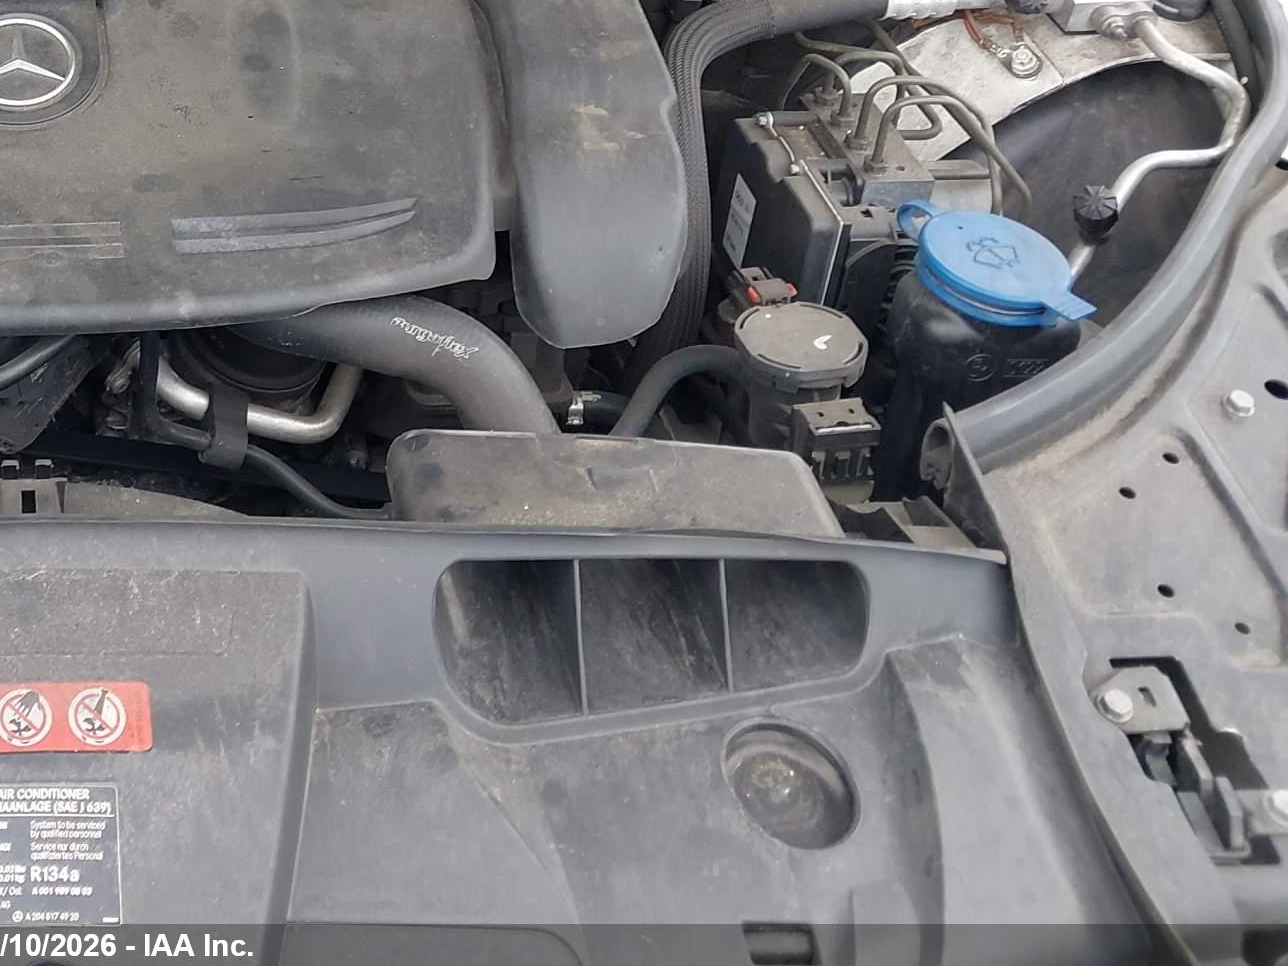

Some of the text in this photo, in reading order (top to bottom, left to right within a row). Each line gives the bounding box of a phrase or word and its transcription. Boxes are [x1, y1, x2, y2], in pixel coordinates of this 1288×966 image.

[16, 788, 90, 800] CONDITIONER
[53, 801, 78, 815] (SAE
[86, 802, 112, 815] 639)
[30, 865, 81, 883] R134a
